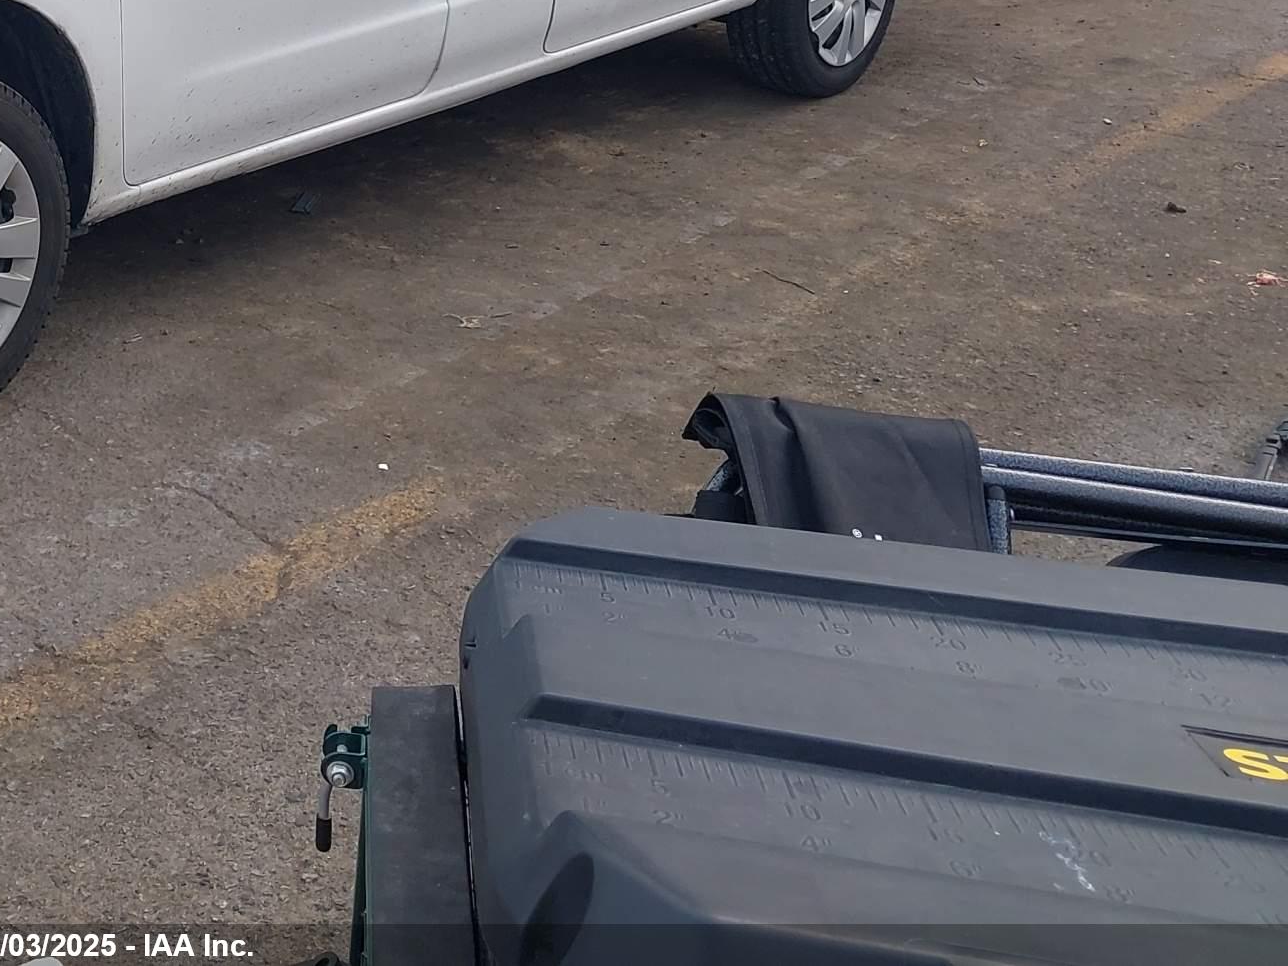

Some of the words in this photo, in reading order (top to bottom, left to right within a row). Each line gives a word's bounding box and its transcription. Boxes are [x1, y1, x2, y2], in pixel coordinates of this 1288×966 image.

[599, 590, 618, 605] 5
[704, 605, 737, 621] 10
[817, 620, 852, 636] 15
[785, 801, 822, 822] 10
